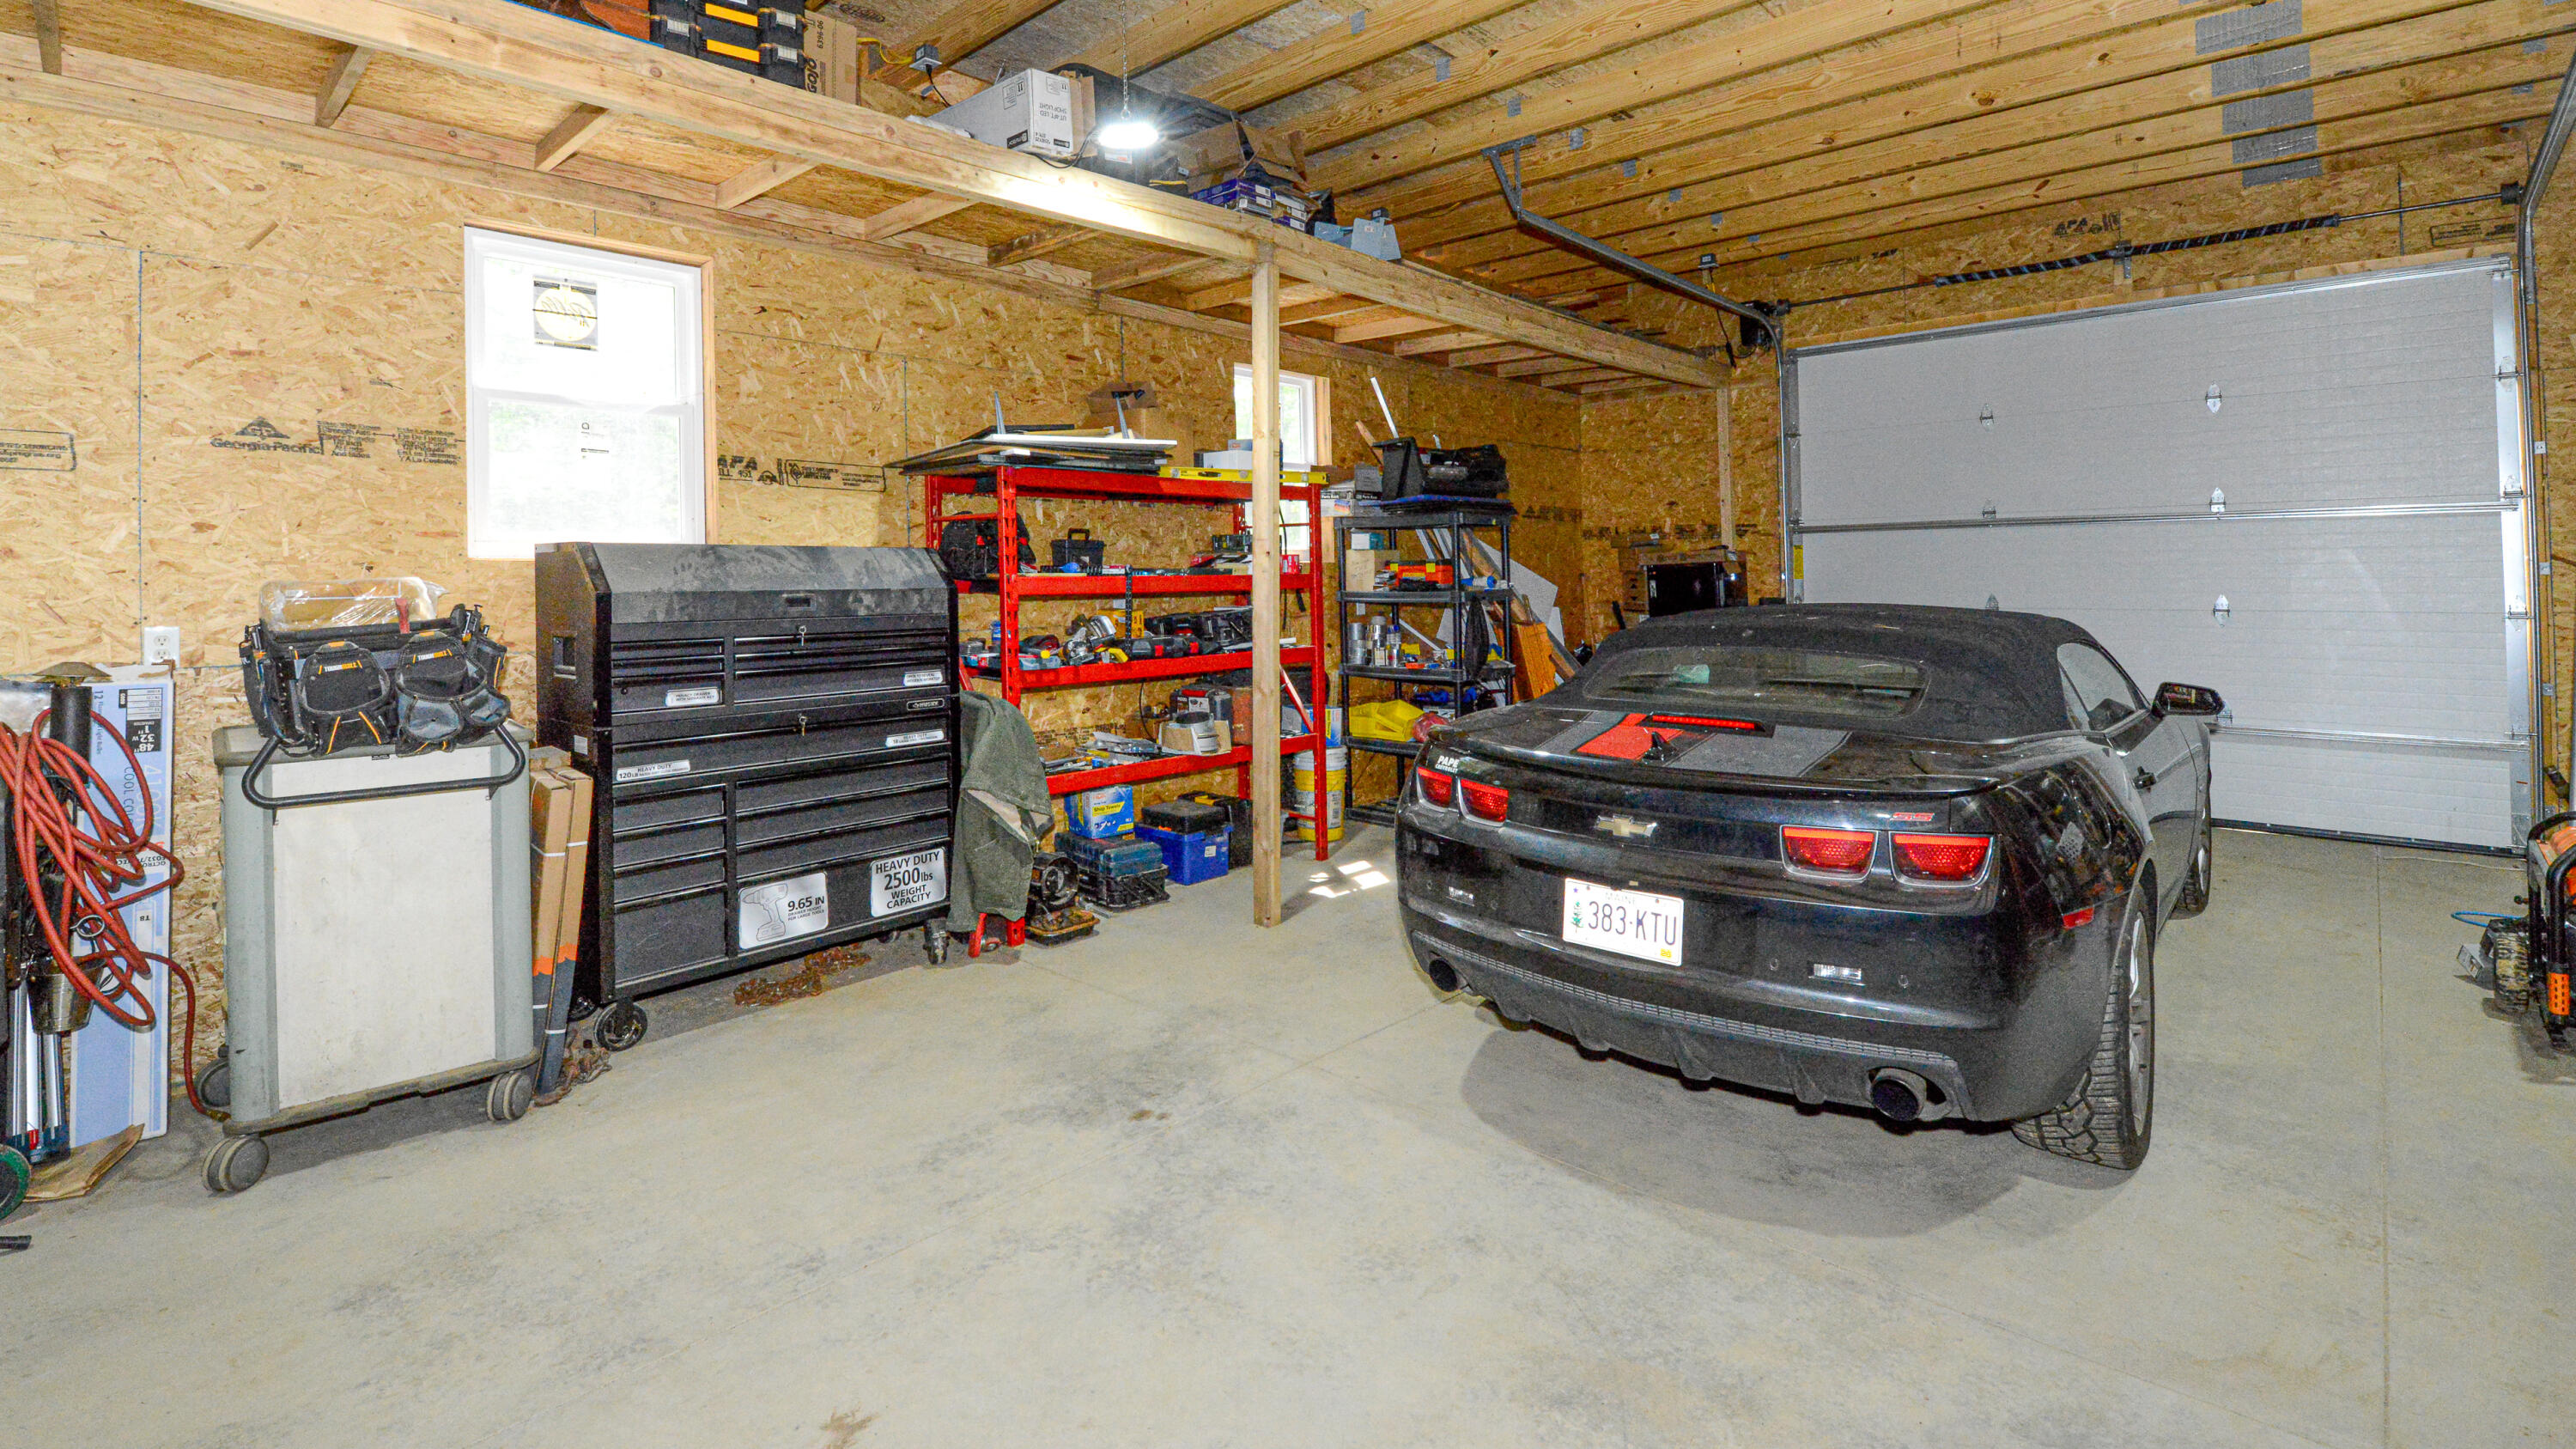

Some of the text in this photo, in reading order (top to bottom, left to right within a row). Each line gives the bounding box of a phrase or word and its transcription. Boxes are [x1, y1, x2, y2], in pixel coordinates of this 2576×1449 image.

[807, 58, 818, 93] GOJO
[94, 691, 103, 700] 12
[1435, 764, 1458, 774] CHEVROLET
[1437, 755, 1460, 768] PAPE
[124, 766, 135, 795] COOL
[1890, 812, 1935, 822] SS
[876, 850, 940, 874] HEAVY DUTY
[891, 884, 927, 900] WEIGHT
[787, 896, 825, 912] 9.65 IN
[887, 892, 931, 909] CAPACITY
